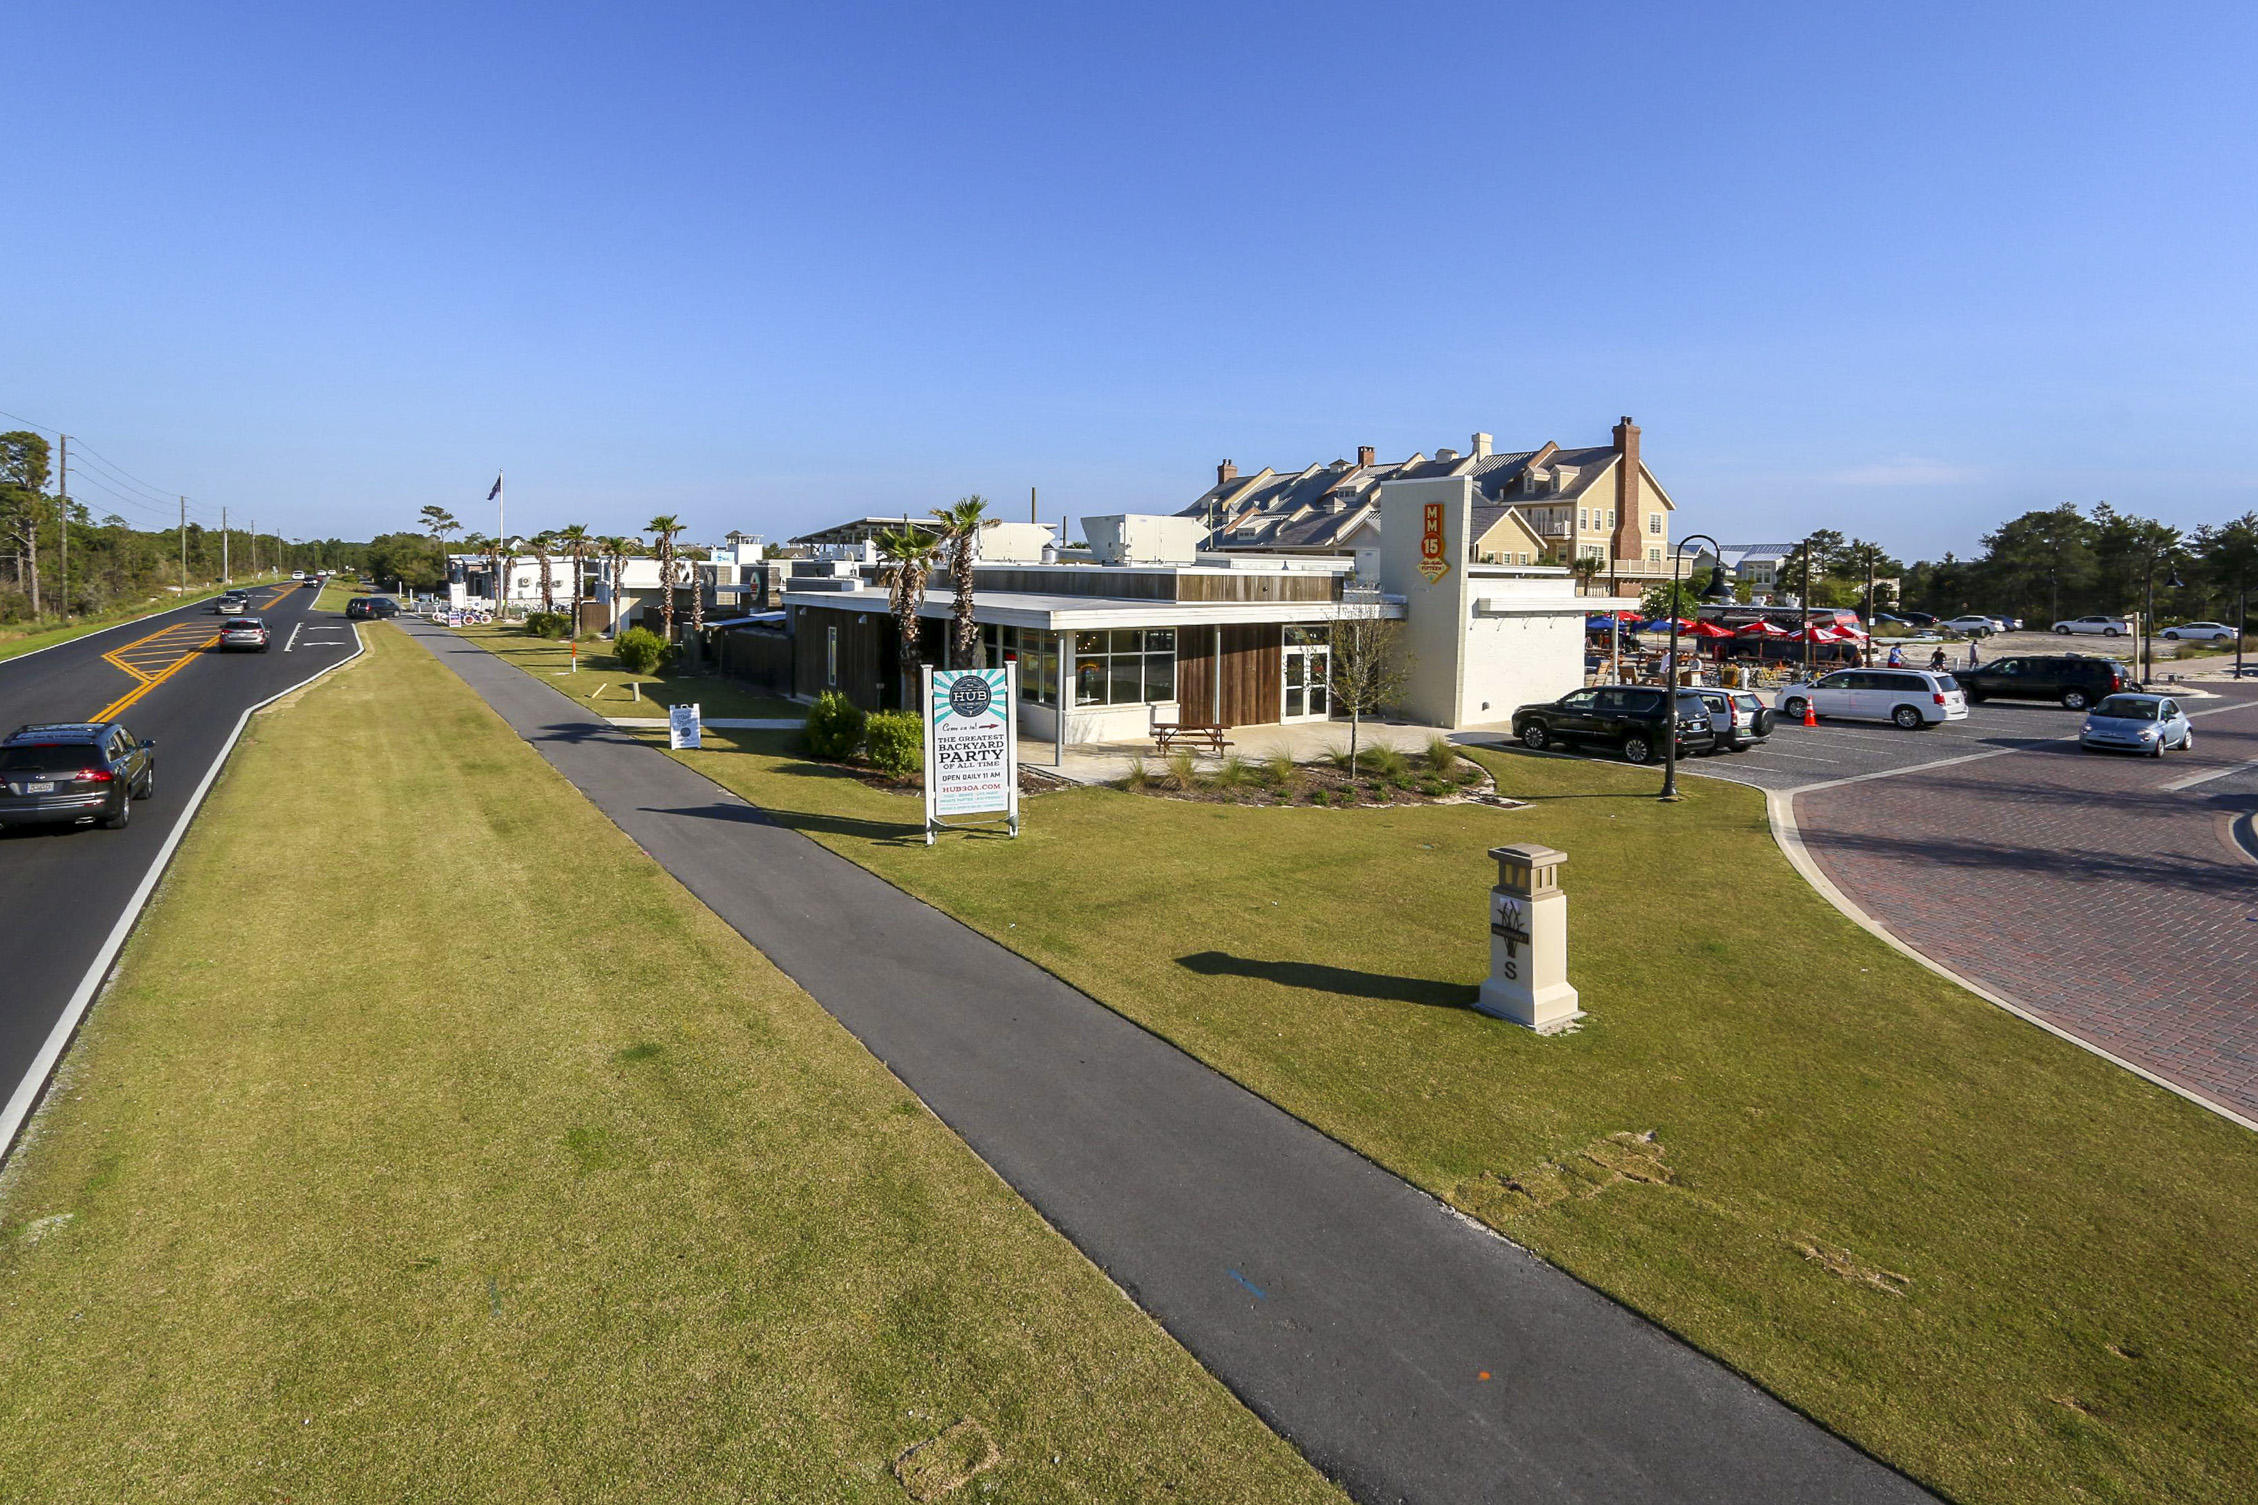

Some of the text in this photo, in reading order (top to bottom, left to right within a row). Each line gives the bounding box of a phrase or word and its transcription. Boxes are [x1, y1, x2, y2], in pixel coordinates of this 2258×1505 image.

[1424, 539, 1439, 554] 15
[953, 691, 986, 701] HUB
[958, 734, 1004, 742] GREATEST
[939, 741, 1004, 751] BACKYARD
[939, 749, 1004, 763] PARTY
[1504, 961, 1517, 980] S
